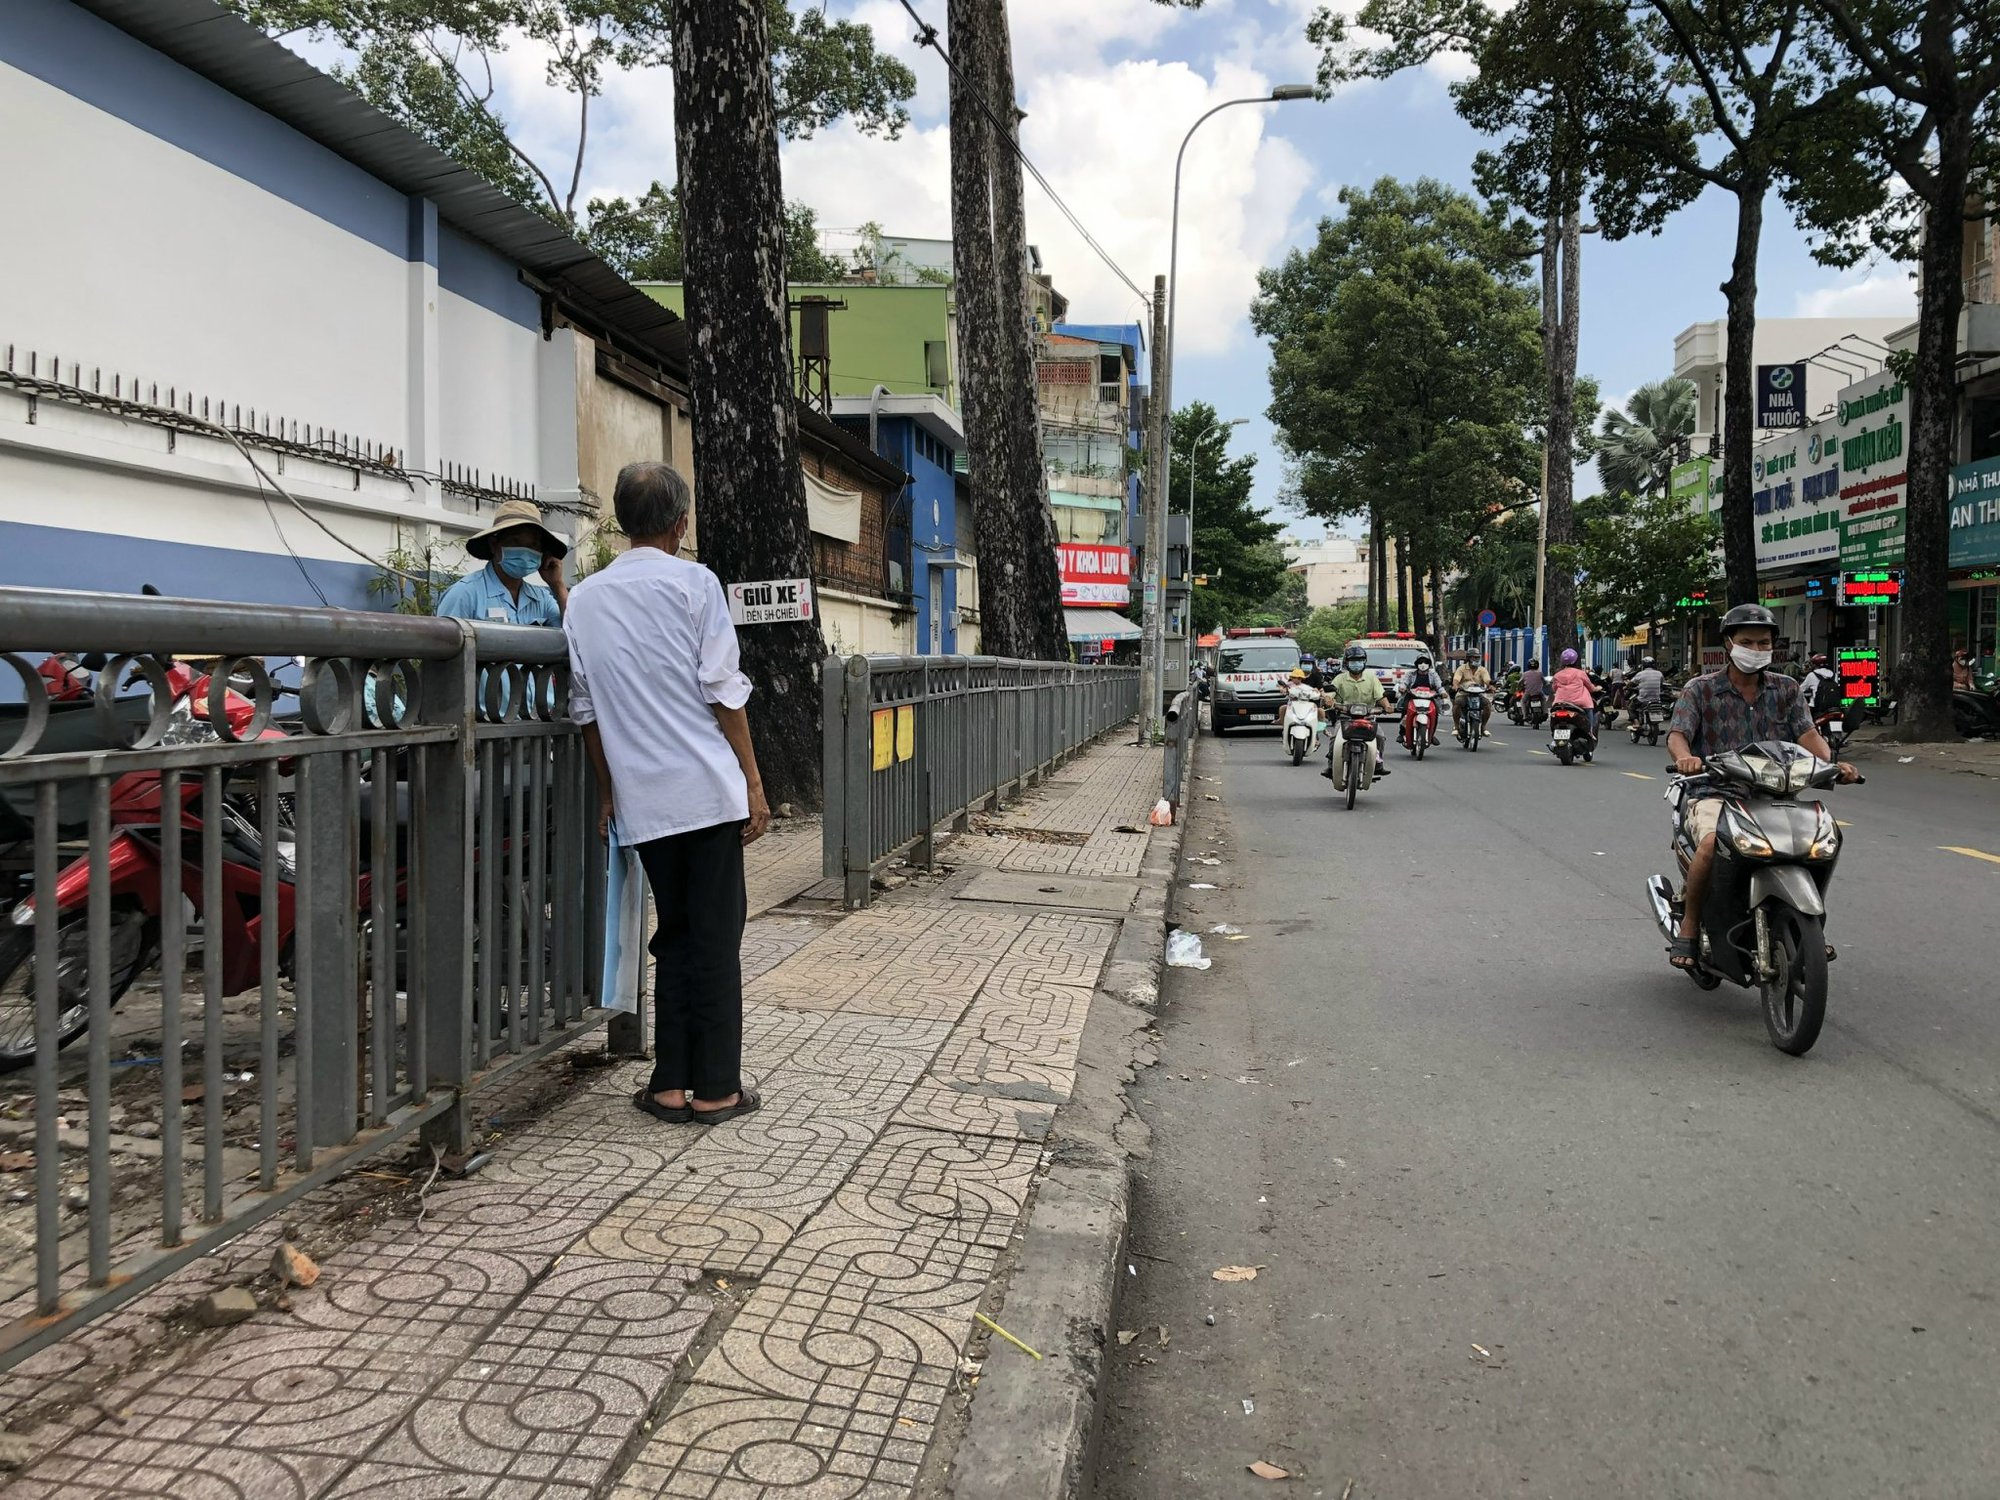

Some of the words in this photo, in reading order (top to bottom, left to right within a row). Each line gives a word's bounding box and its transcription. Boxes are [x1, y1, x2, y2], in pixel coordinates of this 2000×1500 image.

[1769, 390, 1794, 408] NHÀ
[1762, 408, 1801, 427] THUỐC
[1958, 471, 1979, 494] NHÀ
[1950, 503, 1974, 529] AN
[1067, 549, 1076, 574] Y
[1075, 550, 1101, 575] KHOA
[743, 583, 772, 606] GIỮ
[776, 585, 797, 604] XE
[1225, 673, 1290, 683] AMBULANC
[1841, 659, 1877, 679] THUẬN
